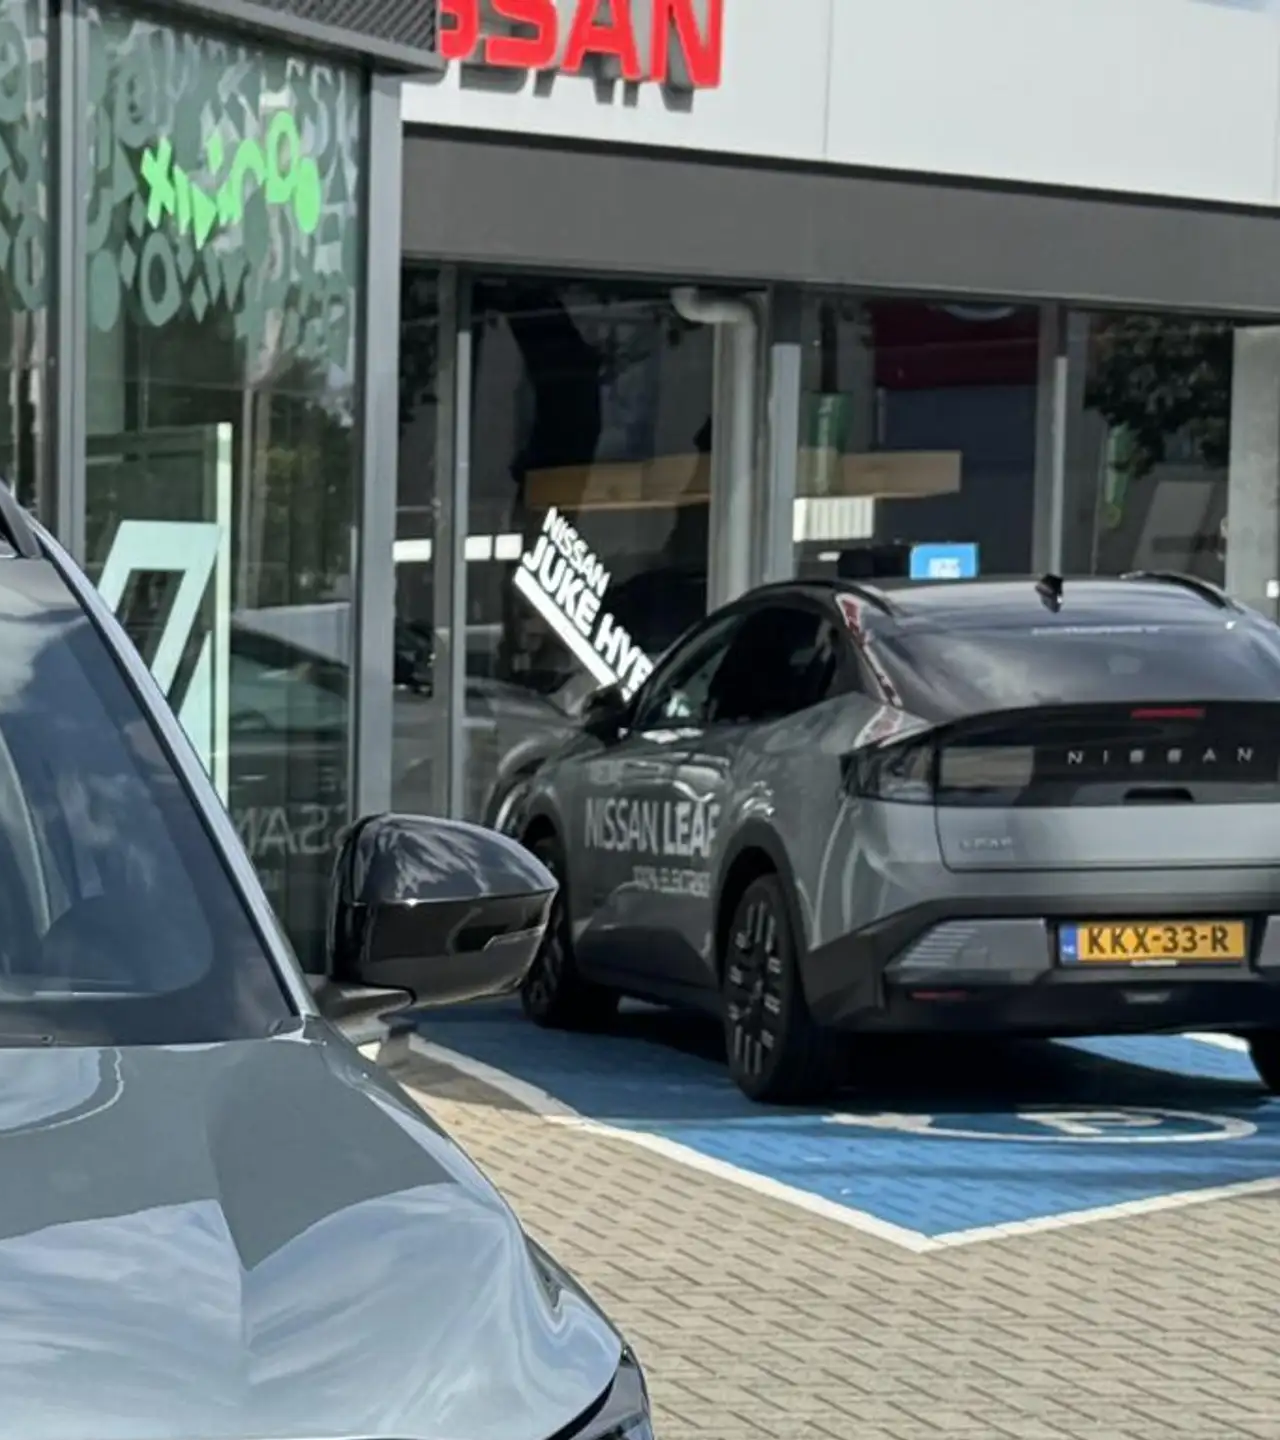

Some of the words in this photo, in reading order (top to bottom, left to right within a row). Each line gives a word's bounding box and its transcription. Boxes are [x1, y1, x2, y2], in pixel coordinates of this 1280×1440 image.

[542, 506, 612, 598] NISSAN
[522, 535, 602, 637] JUKE
[1068, 748, 1254, 765] NISSAN
[584, 798, 659, 856] NISSAN
[663, 800, 721, 858] LEAF
[1088, 925, 1229, 955] KKX-33-R
